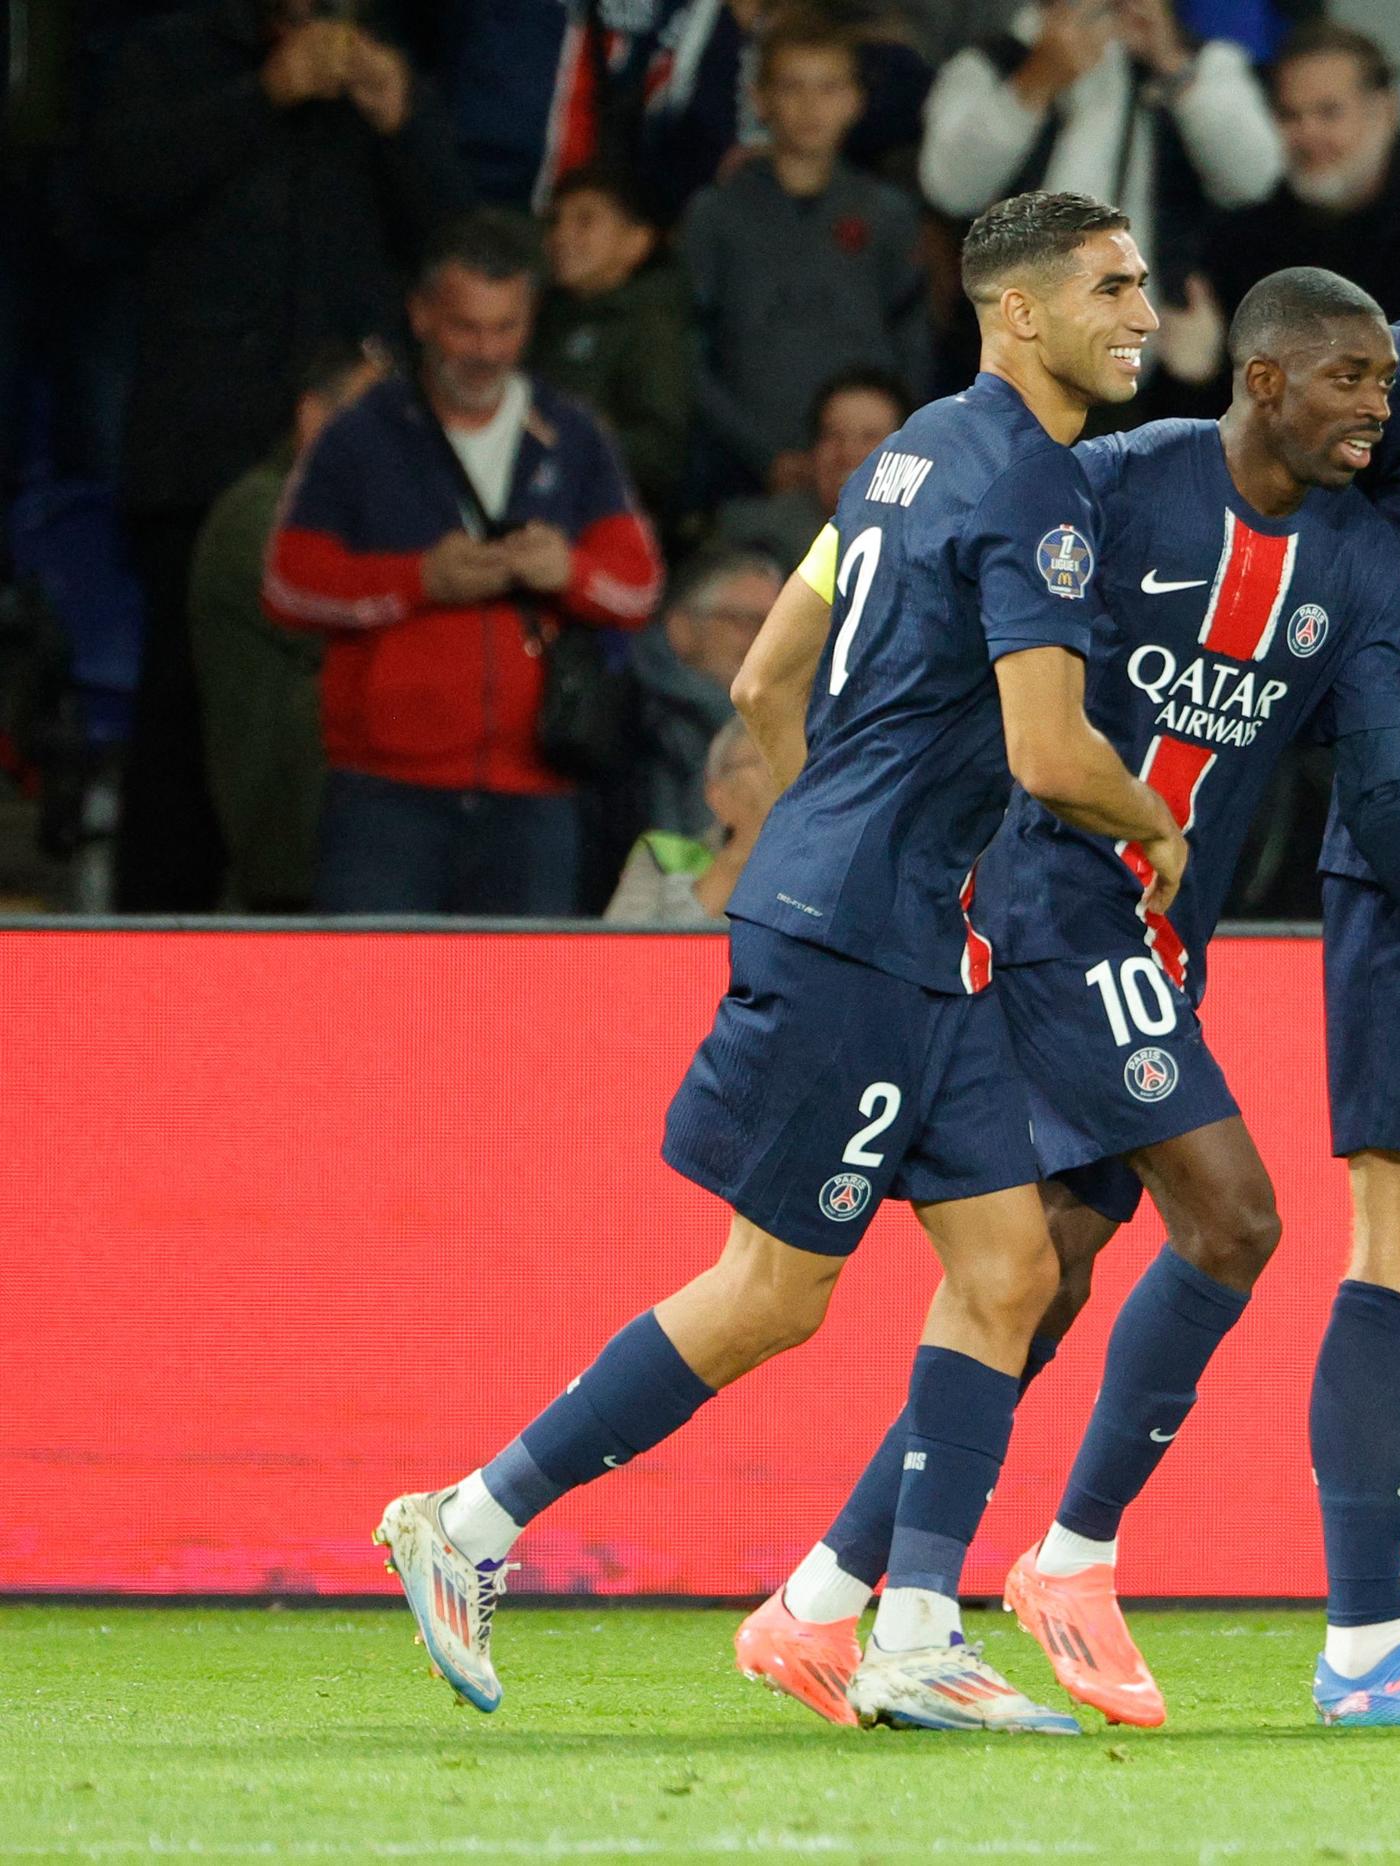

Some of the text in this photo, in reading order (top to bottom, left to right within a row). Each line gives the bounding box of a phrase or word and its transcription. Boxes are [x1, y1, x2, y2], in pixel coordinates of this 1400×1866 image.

[1299, 607, 1325, 624] PARIS
[1127, 644, 1288, 719] QATAR
[1085, 956, 1177, 1047] 10
[1128, 1050, 1161, 1070] PARIS
[841, 1081, 902, 1168] 2
[833, 1176, 867, 1190] PARIS
